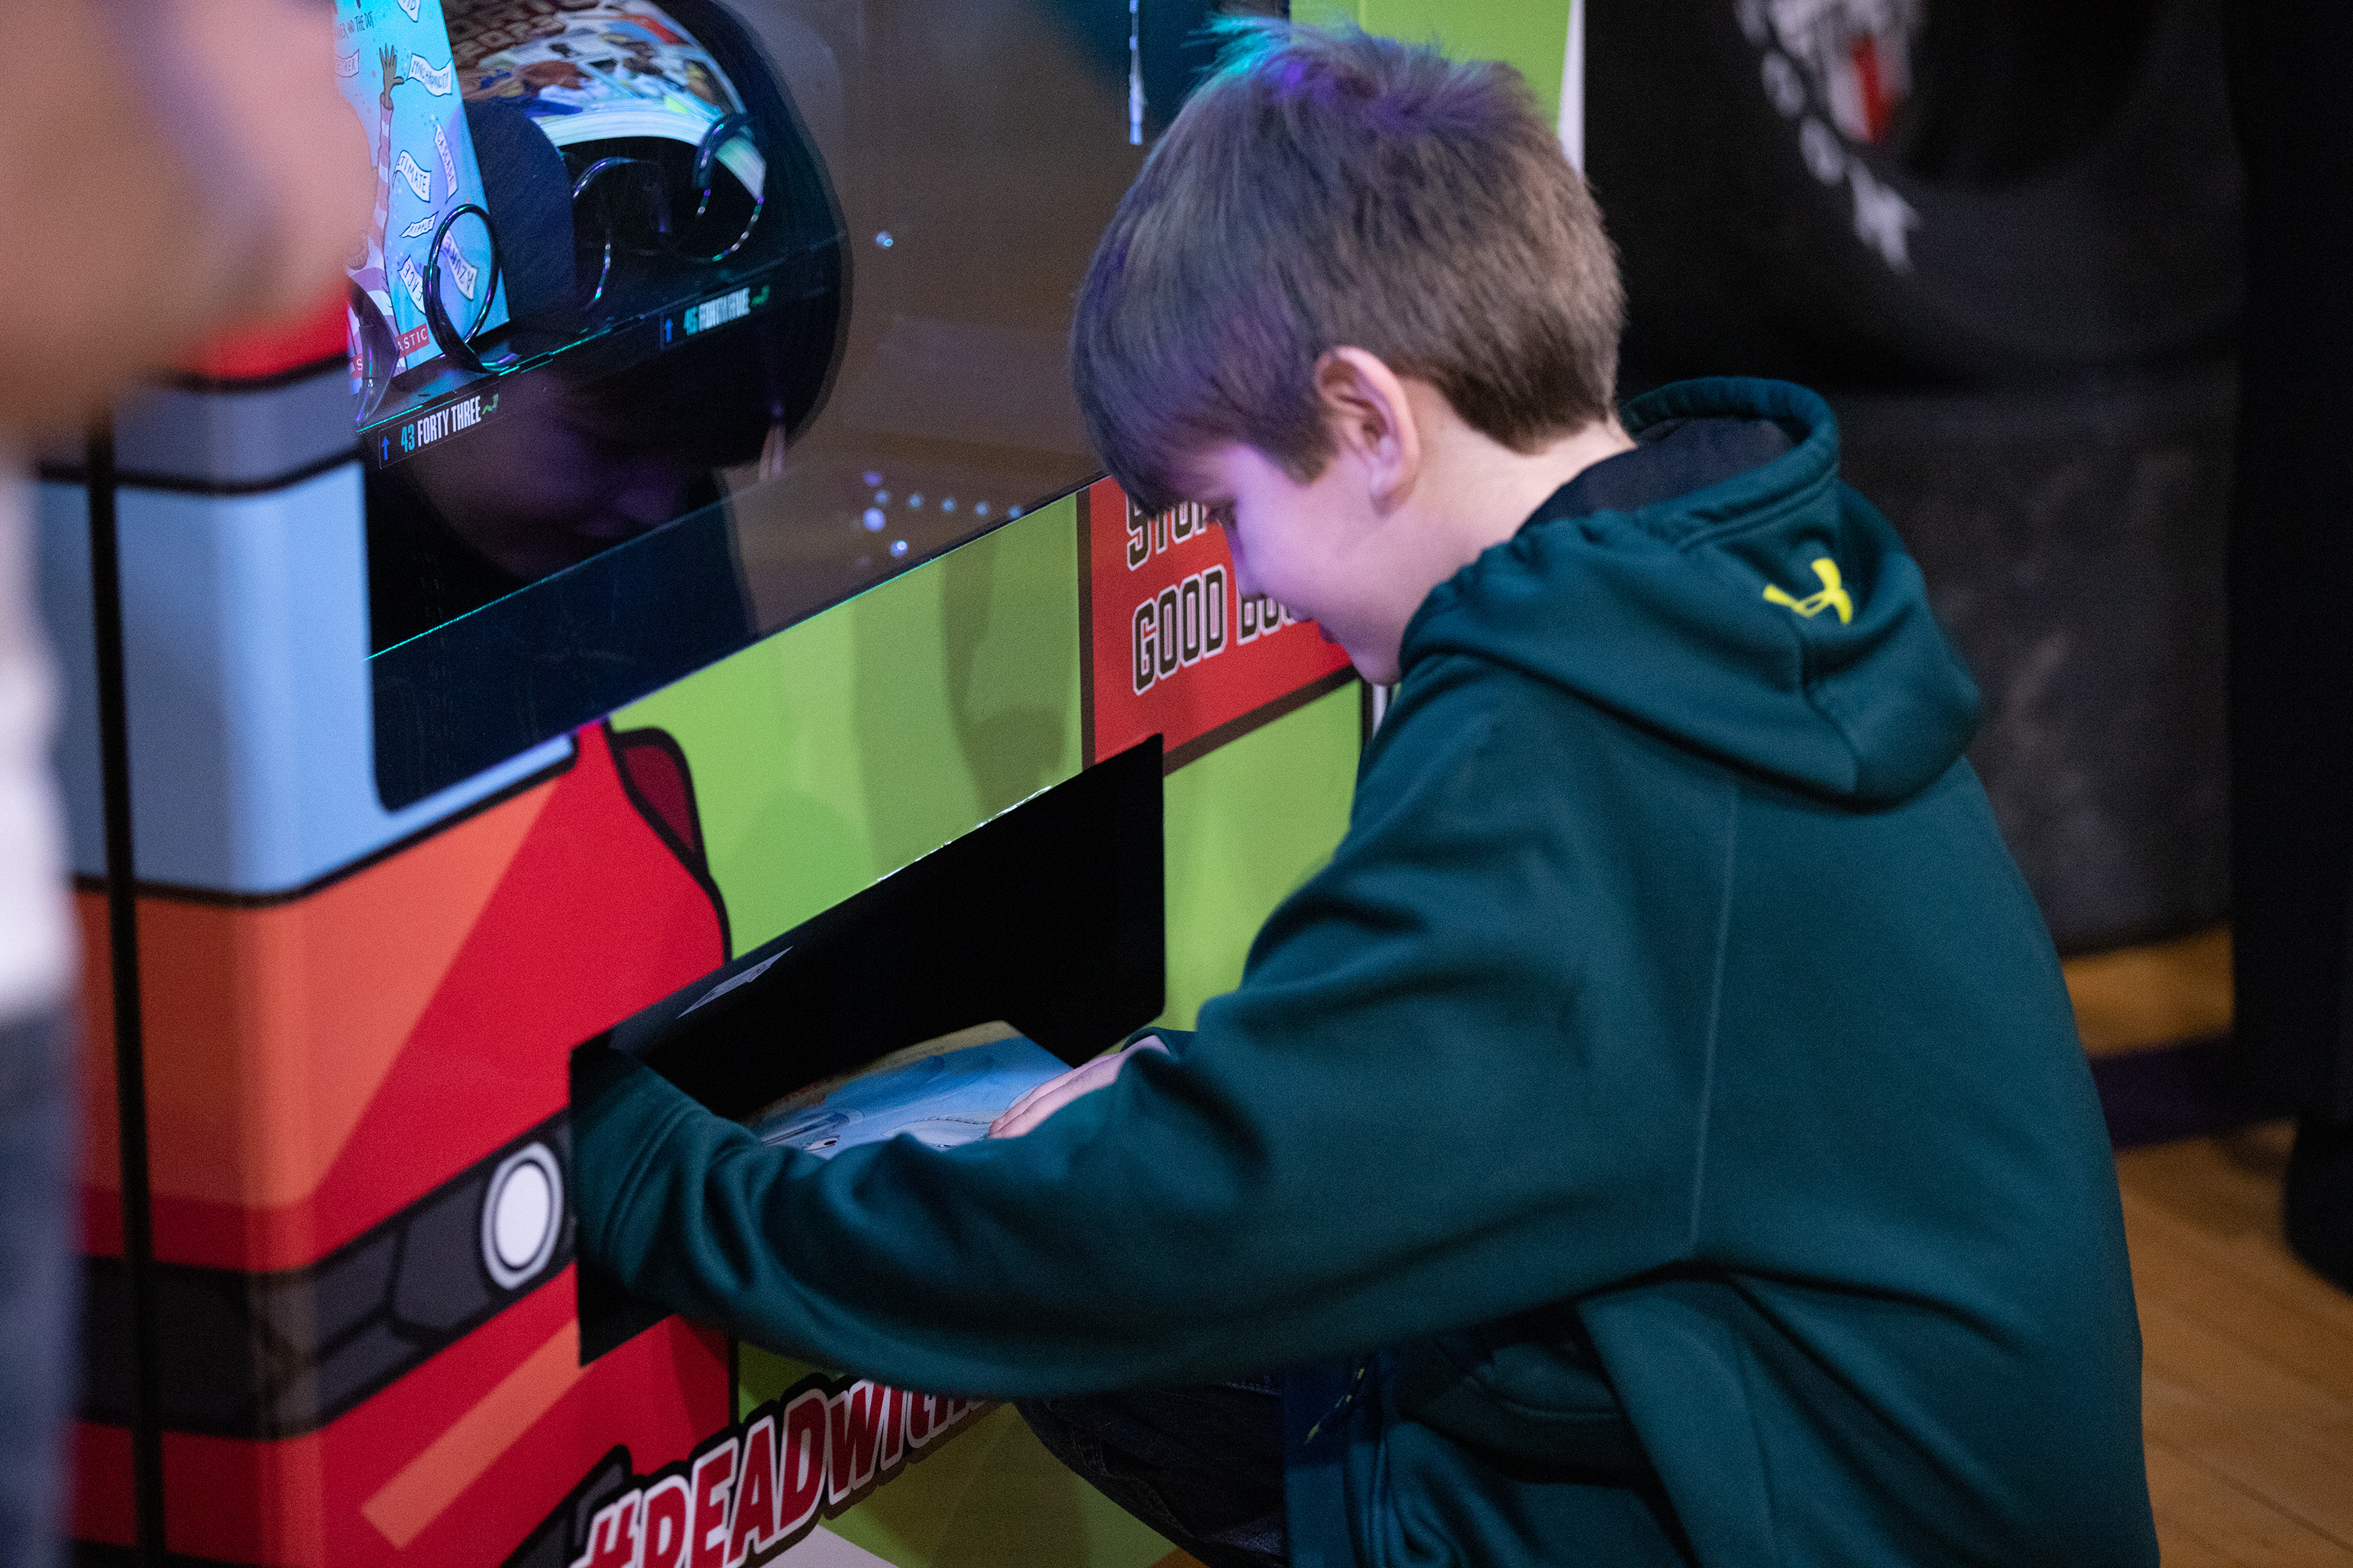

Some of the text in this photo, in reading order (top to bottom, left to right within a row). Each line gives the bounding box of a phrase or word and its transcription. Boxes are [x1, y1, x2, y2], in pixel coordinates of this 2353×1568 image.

[400, 395, 482, 453] 43 FORTY THREE
[1131, 564, 1228, 697] GOOD
